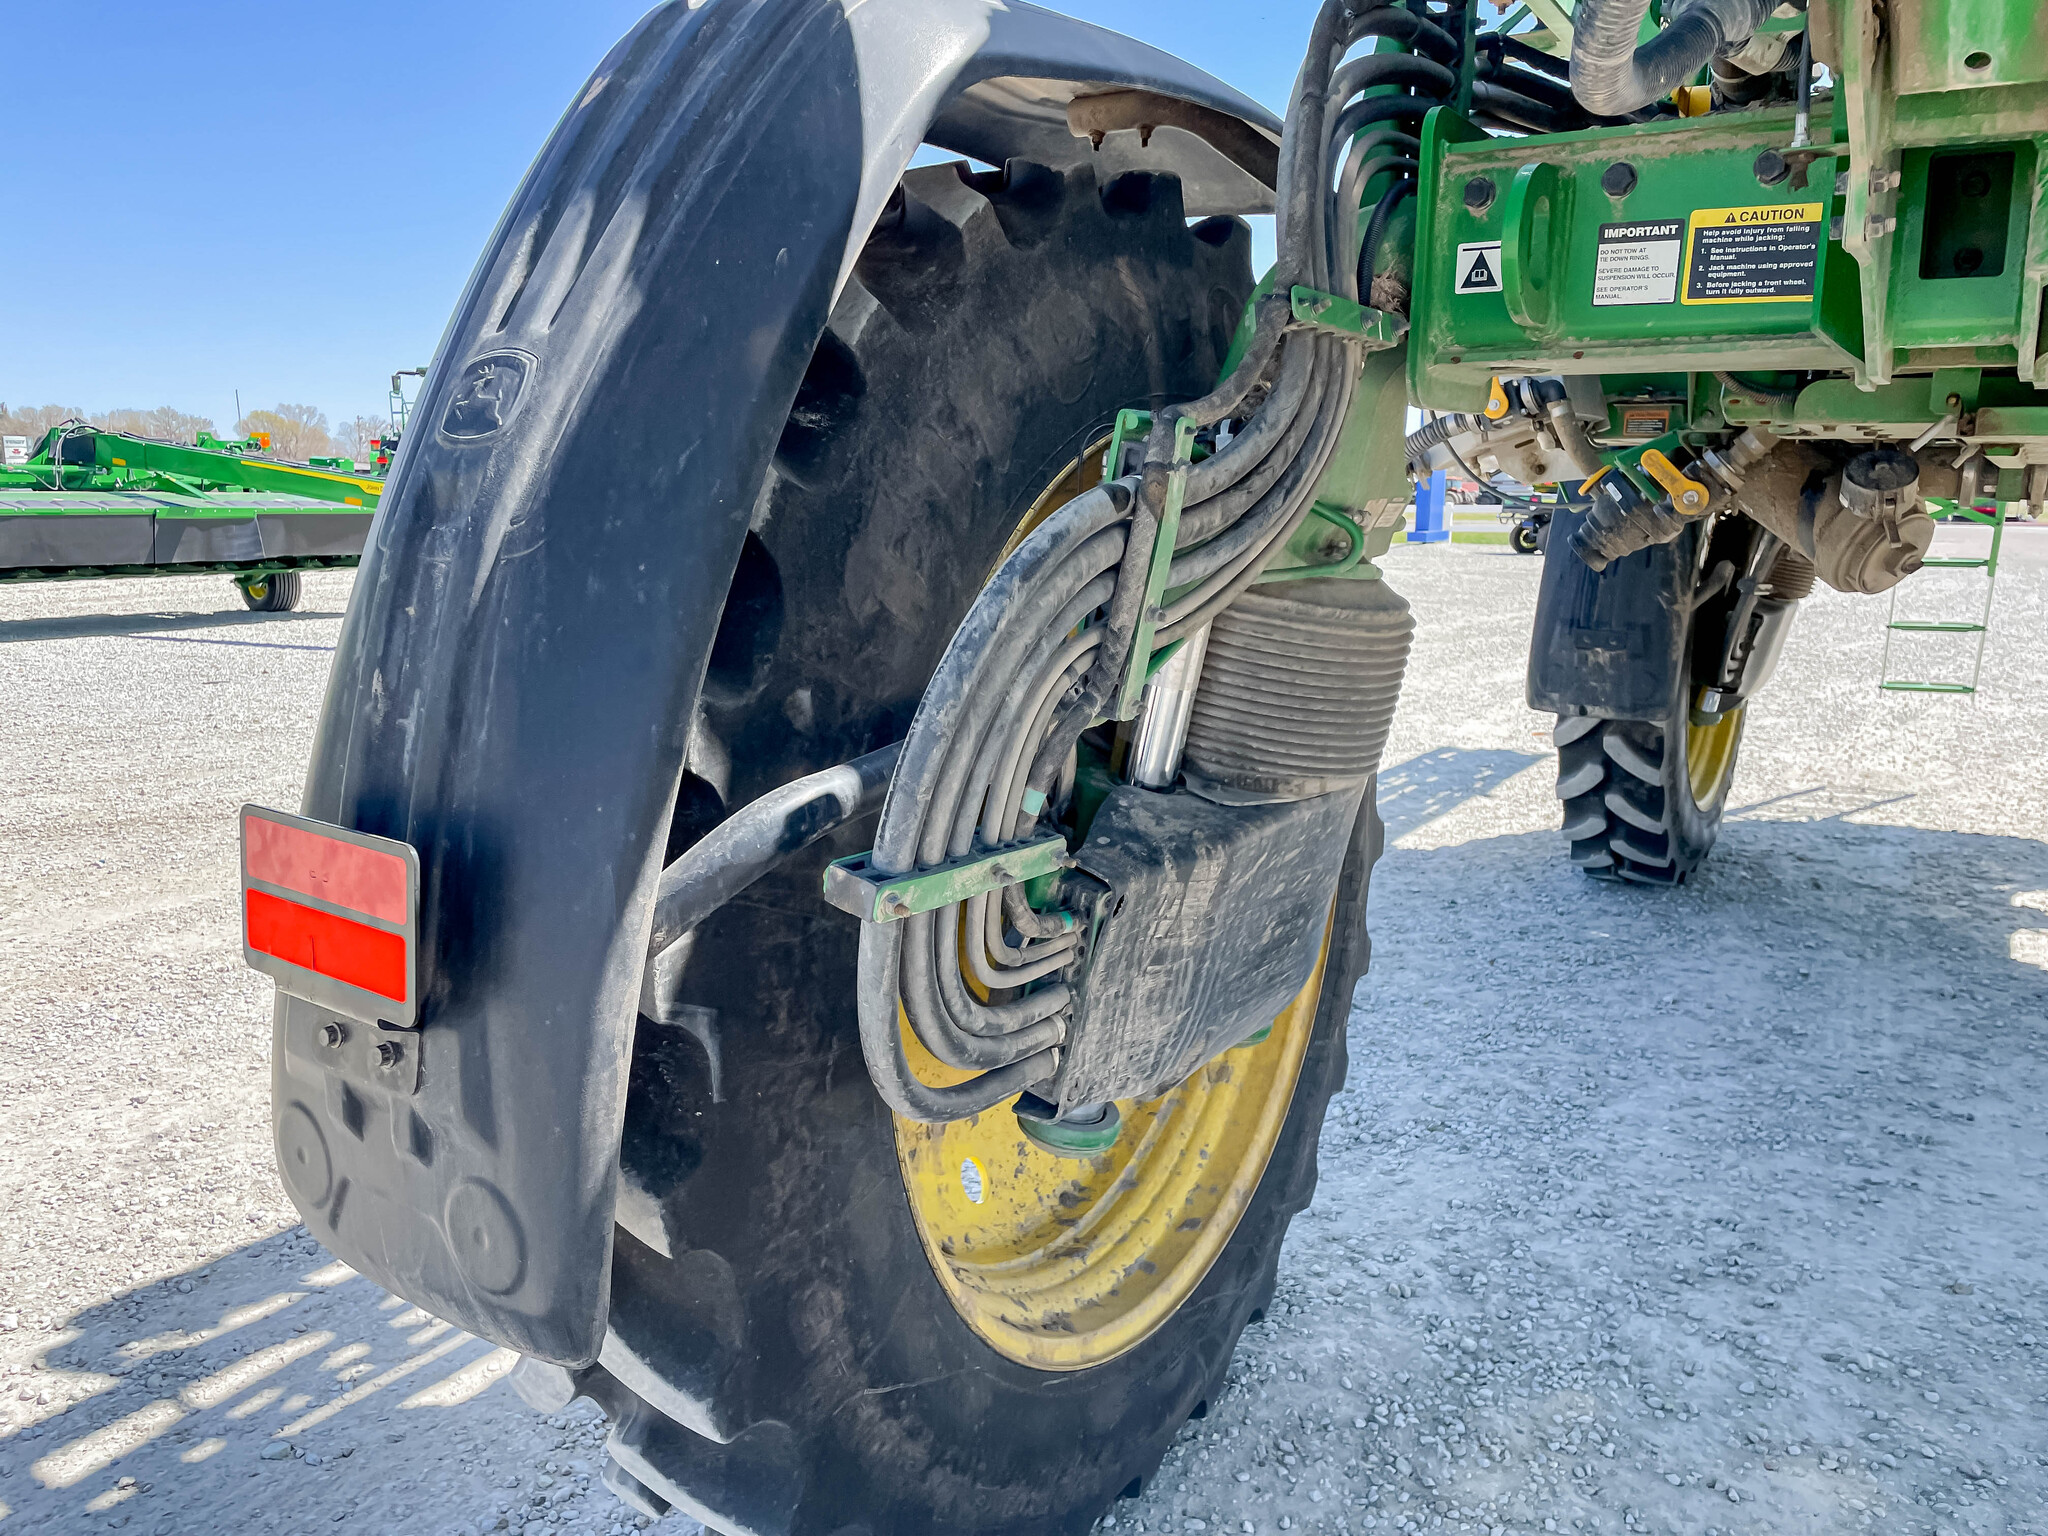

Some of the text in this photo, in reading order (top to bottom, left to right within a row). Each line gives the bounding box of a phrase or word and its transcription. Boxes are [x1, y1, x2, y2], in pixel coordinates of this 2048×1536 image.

[1740, 208, 1804, 222] CAUTION
[1604, 225, 1679, 238] IMPORTANT
[1721, 228, 1742, 236] avoid
[1786, 225, 1810, 233] falling
[1702, 236, 1733, 244] machine
[1755, 234, 1786, 242] jacking:
[1778, 243, 1816, 252] Operator's
[1779, 261, 1813, 269] approved
[1707, 271, 1746, 279] equipment.
